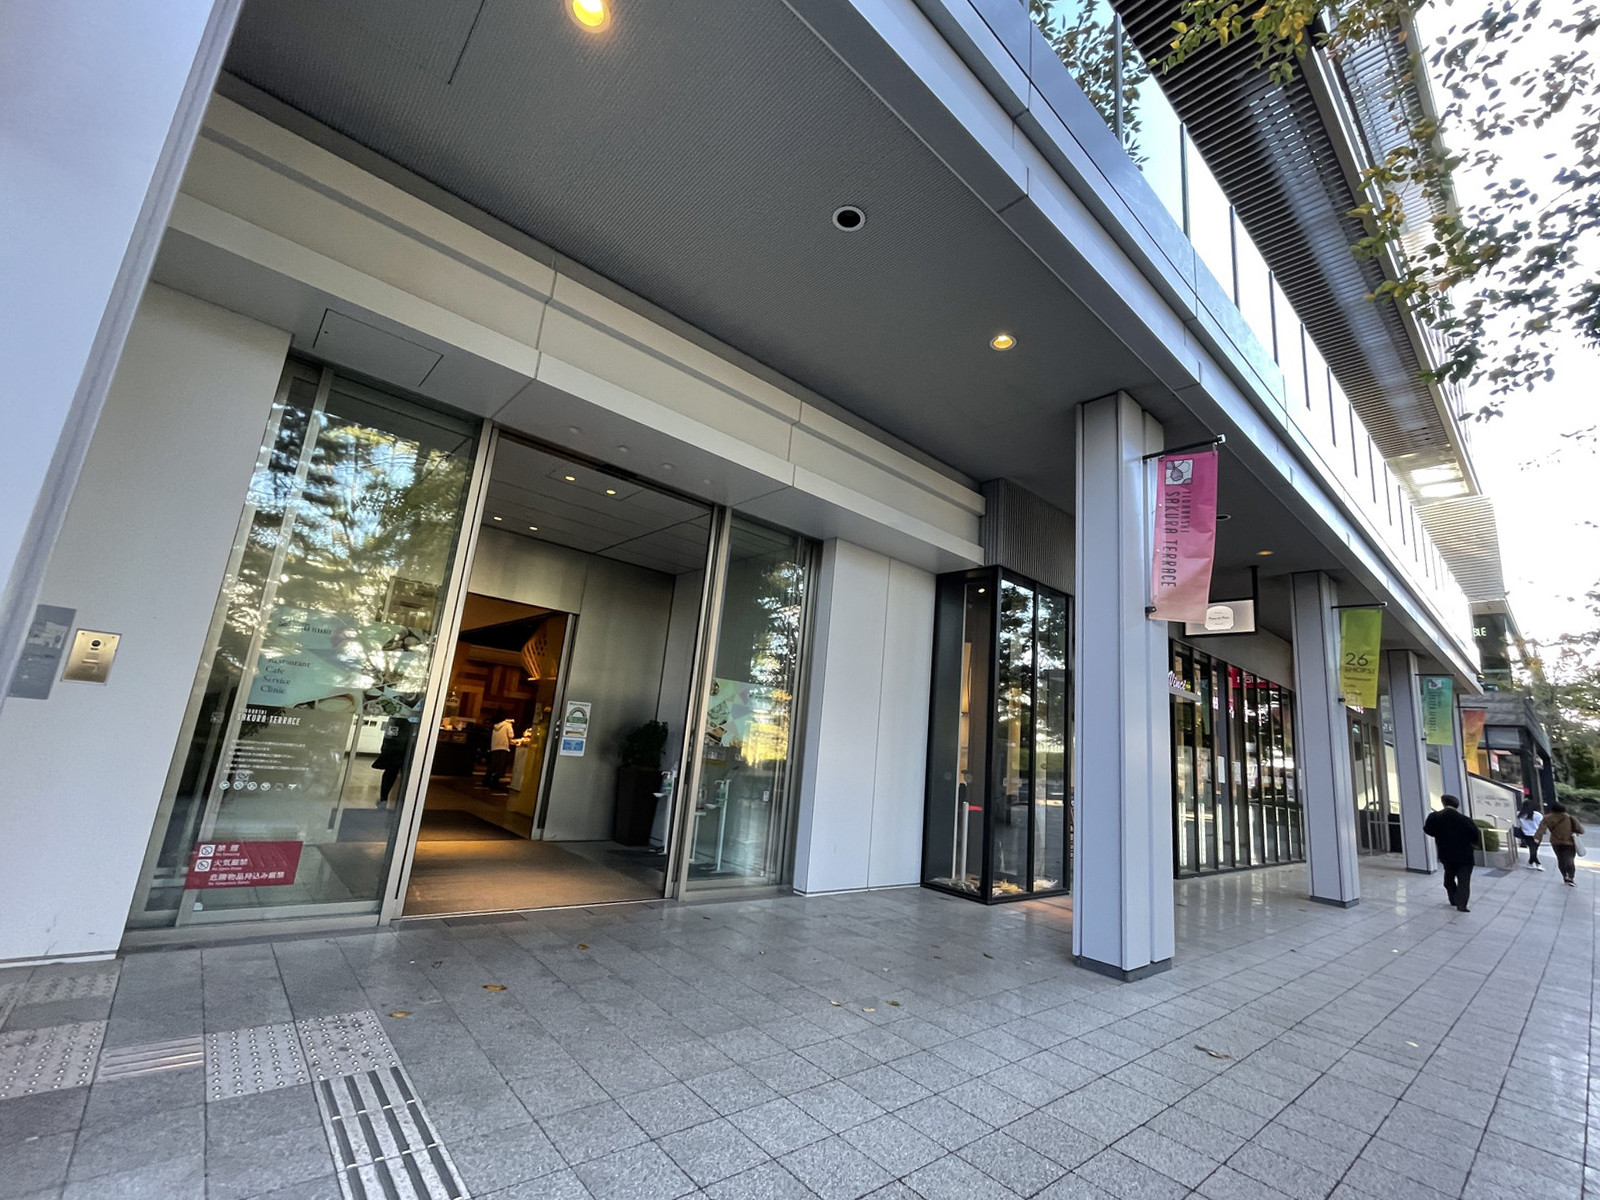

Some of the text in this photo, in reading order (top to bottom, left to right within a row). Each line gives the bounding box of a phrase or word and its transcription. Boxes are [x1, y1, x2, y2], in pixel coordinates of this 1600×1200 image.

[1161, 491, 1180, 587] SAKURA TERRACE
[1345, 652, 1369, 667] 26
[260, 685, 286, 694] Clinic
[237, 713, 301, 726] SAKURA TERRACE
